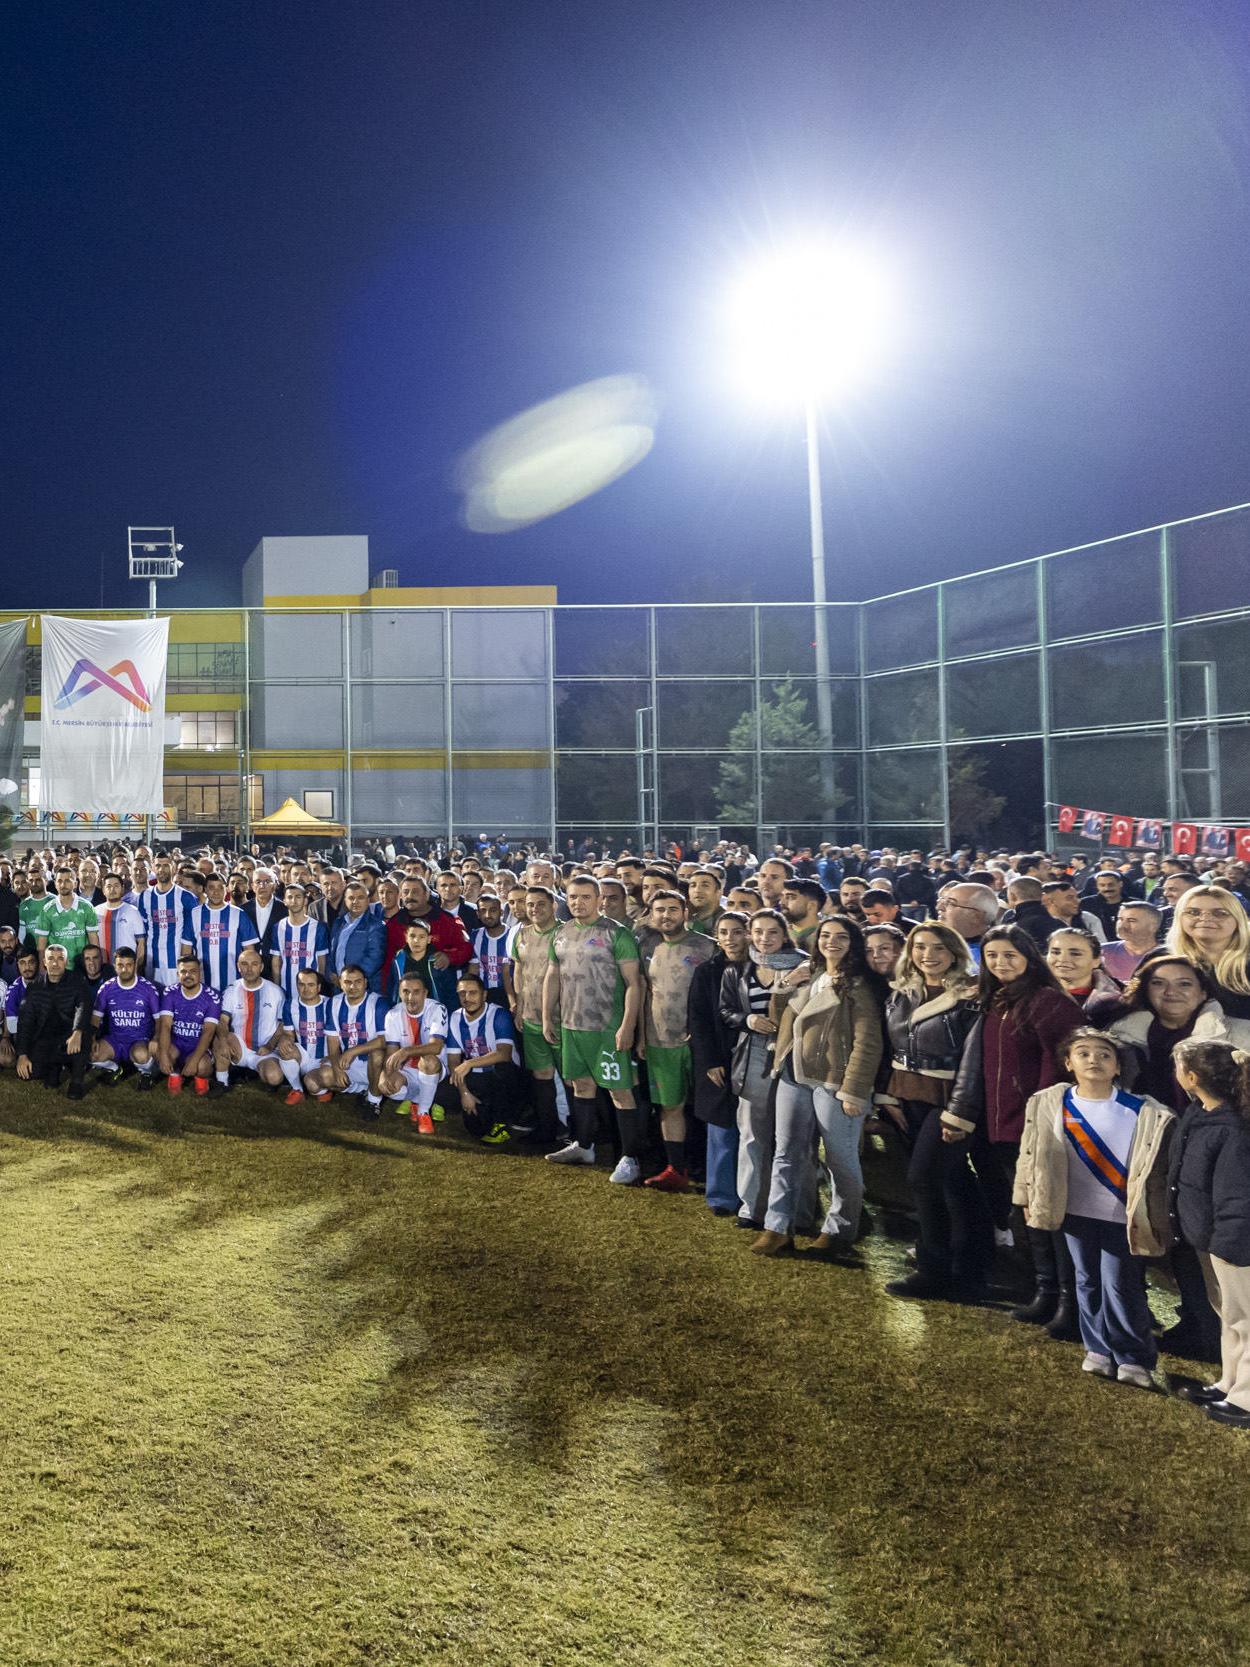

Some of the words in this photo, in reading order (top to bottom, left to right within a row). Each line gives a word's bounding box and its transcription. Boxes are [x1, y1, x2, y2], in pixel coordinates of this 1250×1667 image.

[111, 1009, 145, 1019] KÜLTÜR
[114, 1018, 141, 1027] SANAT
[600, 1062, 621, 1080] 33
